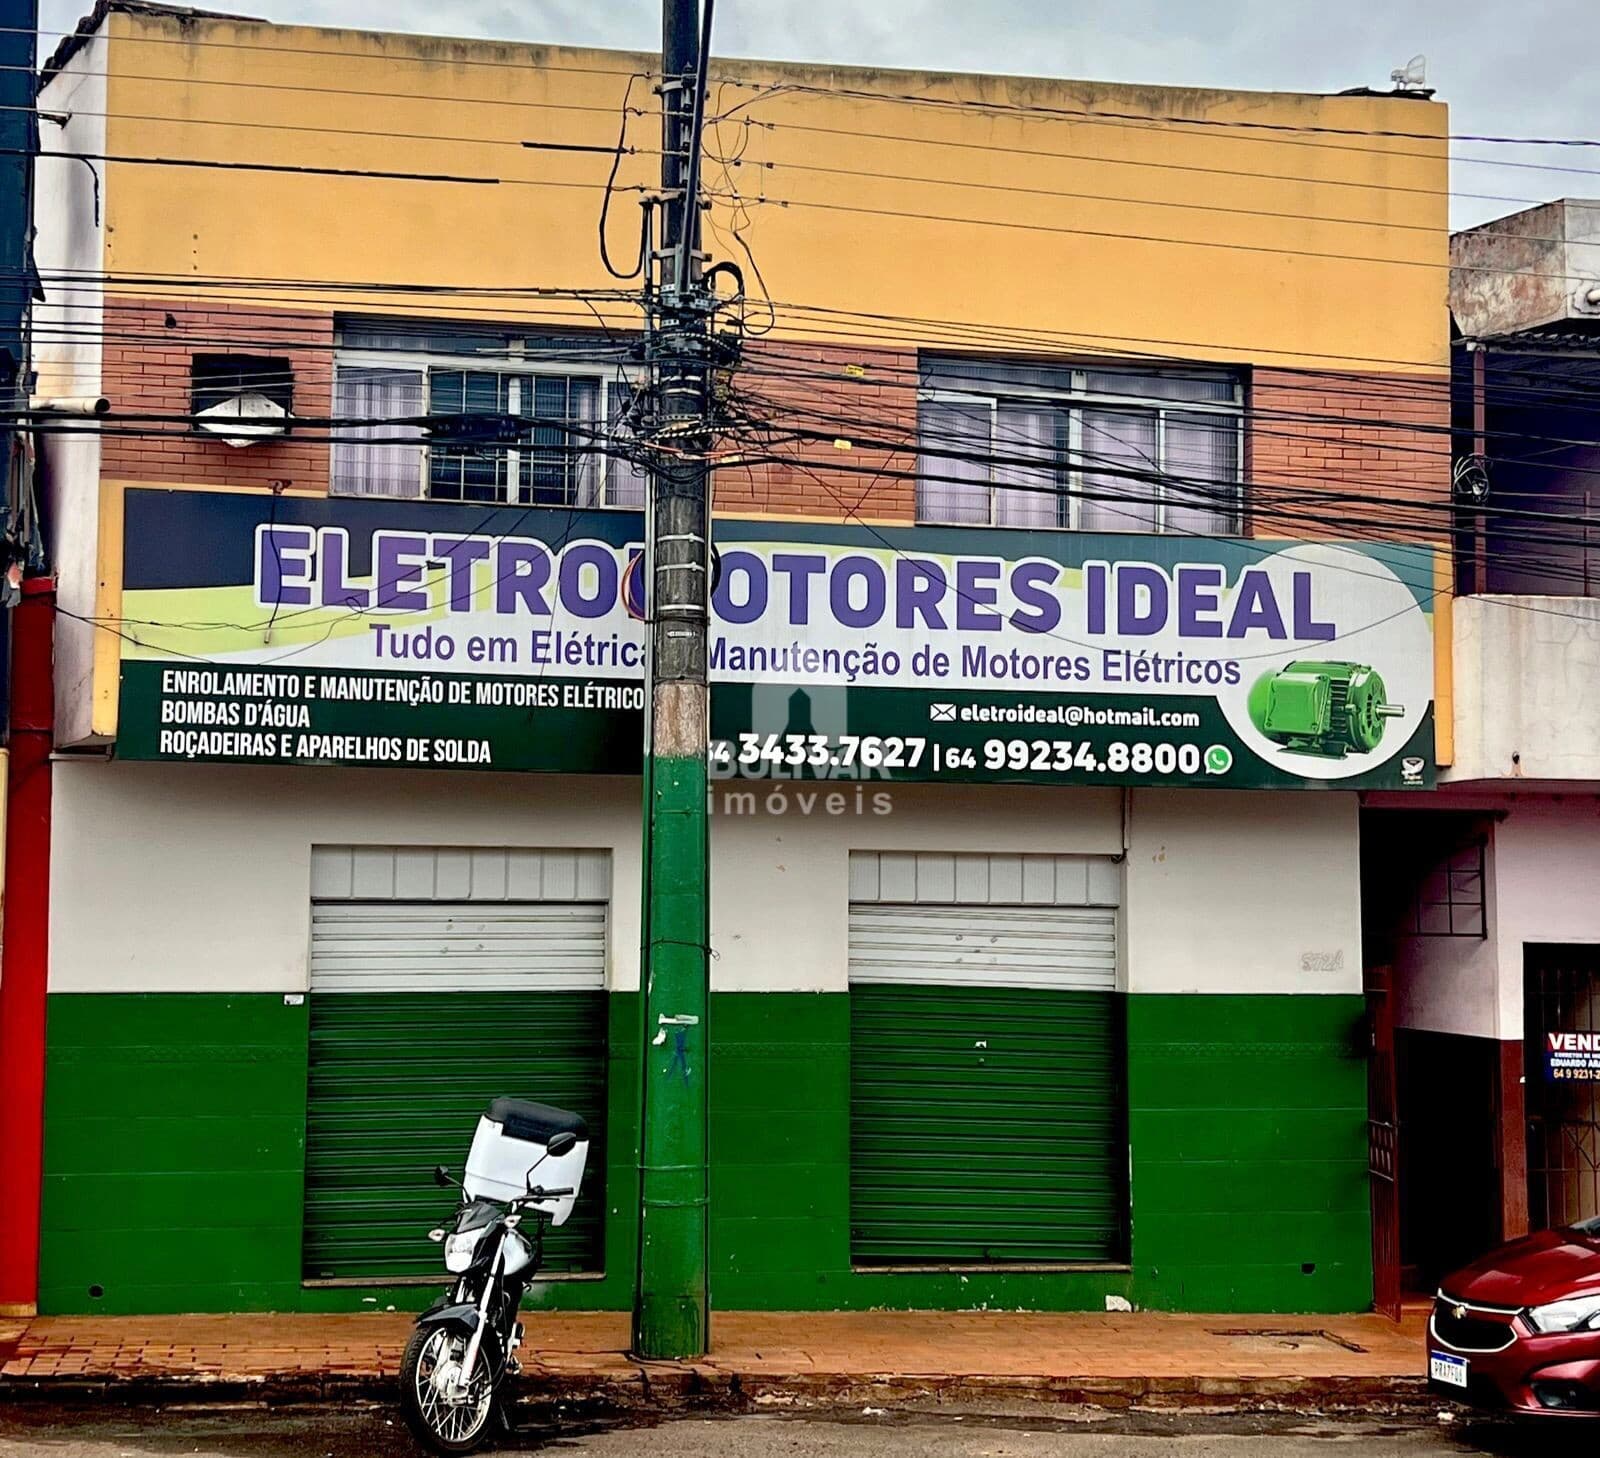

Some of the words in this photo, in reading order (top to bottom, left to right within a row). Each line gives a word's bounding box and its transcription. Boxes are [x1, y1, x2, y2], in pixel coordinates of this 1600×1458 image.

[258, 528, 1063, 635] ELETROOTORES
[1085, 564, 1338, 642] IDEAL
[368, 623, 456, 661] Tudo
[466, 634, 518, 662] em
[709, 635, 902, 682] Manutenção
[911, 643, 950, 677] de
[961, 644, 1091, 681] Motores
[1102, 648, 1242, 685] Elétricos
[162, 669, 300, 698] ENROLAMENTO
[304, 675, 316, 698] E
[320, 676, 444, 706] MANUTENÇÃO
[448, 681, 471, 704] DE
[476, 682, 559, 707] MOTORES
[161, 700, 240, 726] BOMBAS
[244, 699, 311, 728] D'ÁGUA
[960, 704, 1200, 727] eletroideal@hotmail.com
[160, 730, 277, 758] ROÇADEIRAS
[281, 734, 293, 757] E
[296, 734, 402, 760] APARELHOS
[406, 738, 430, 762] DE
[433, 739, 492, 763] SOLDA
[737, 733, 926, 768] 3433.7627
[945, 748, 977, 769] 64
[983, 739, 1200, 774] 99234.8800
